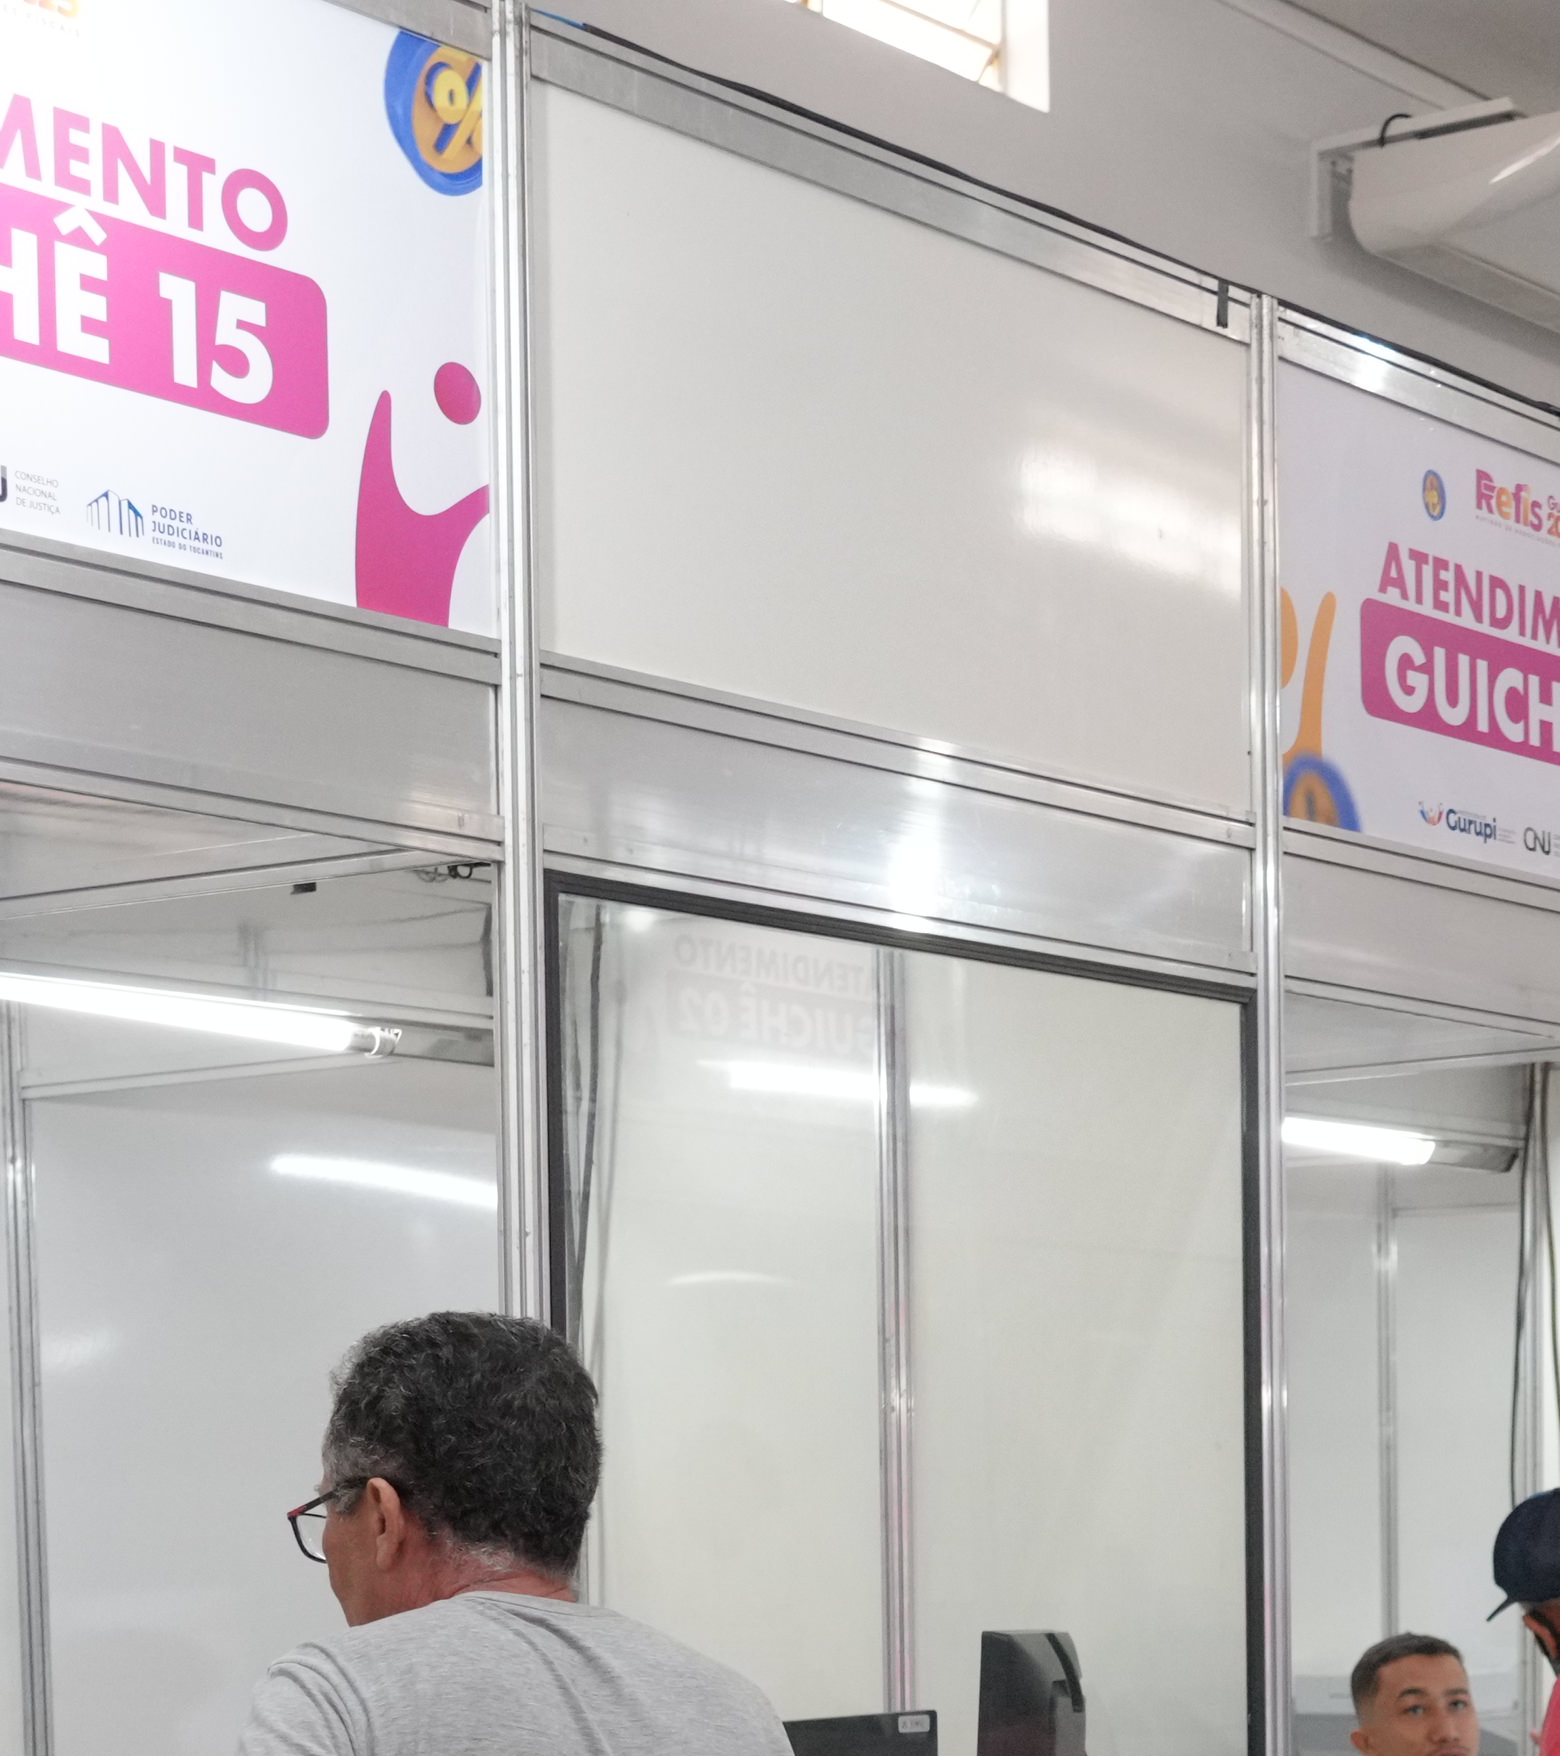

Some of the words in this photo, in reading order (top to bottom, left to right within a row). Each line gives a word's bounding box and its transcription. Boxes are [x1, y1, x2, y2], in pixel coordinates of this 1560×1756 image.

[157, 271, 274, 404] 15
[14, 470, 59, 489] CONSELHO
[15, 484, 57, 502] NACIONAL
[1476, 469, 1543, 532] Refis
[16, 497, 28, 507] DE
[29, 499, 61, 517] JUSTIÇA
[152, 504, 193, 525] PODER
[152, 520, 222, 548] JUDICIÁRIO
[1446, 808, 1497, 843] Gurupi
